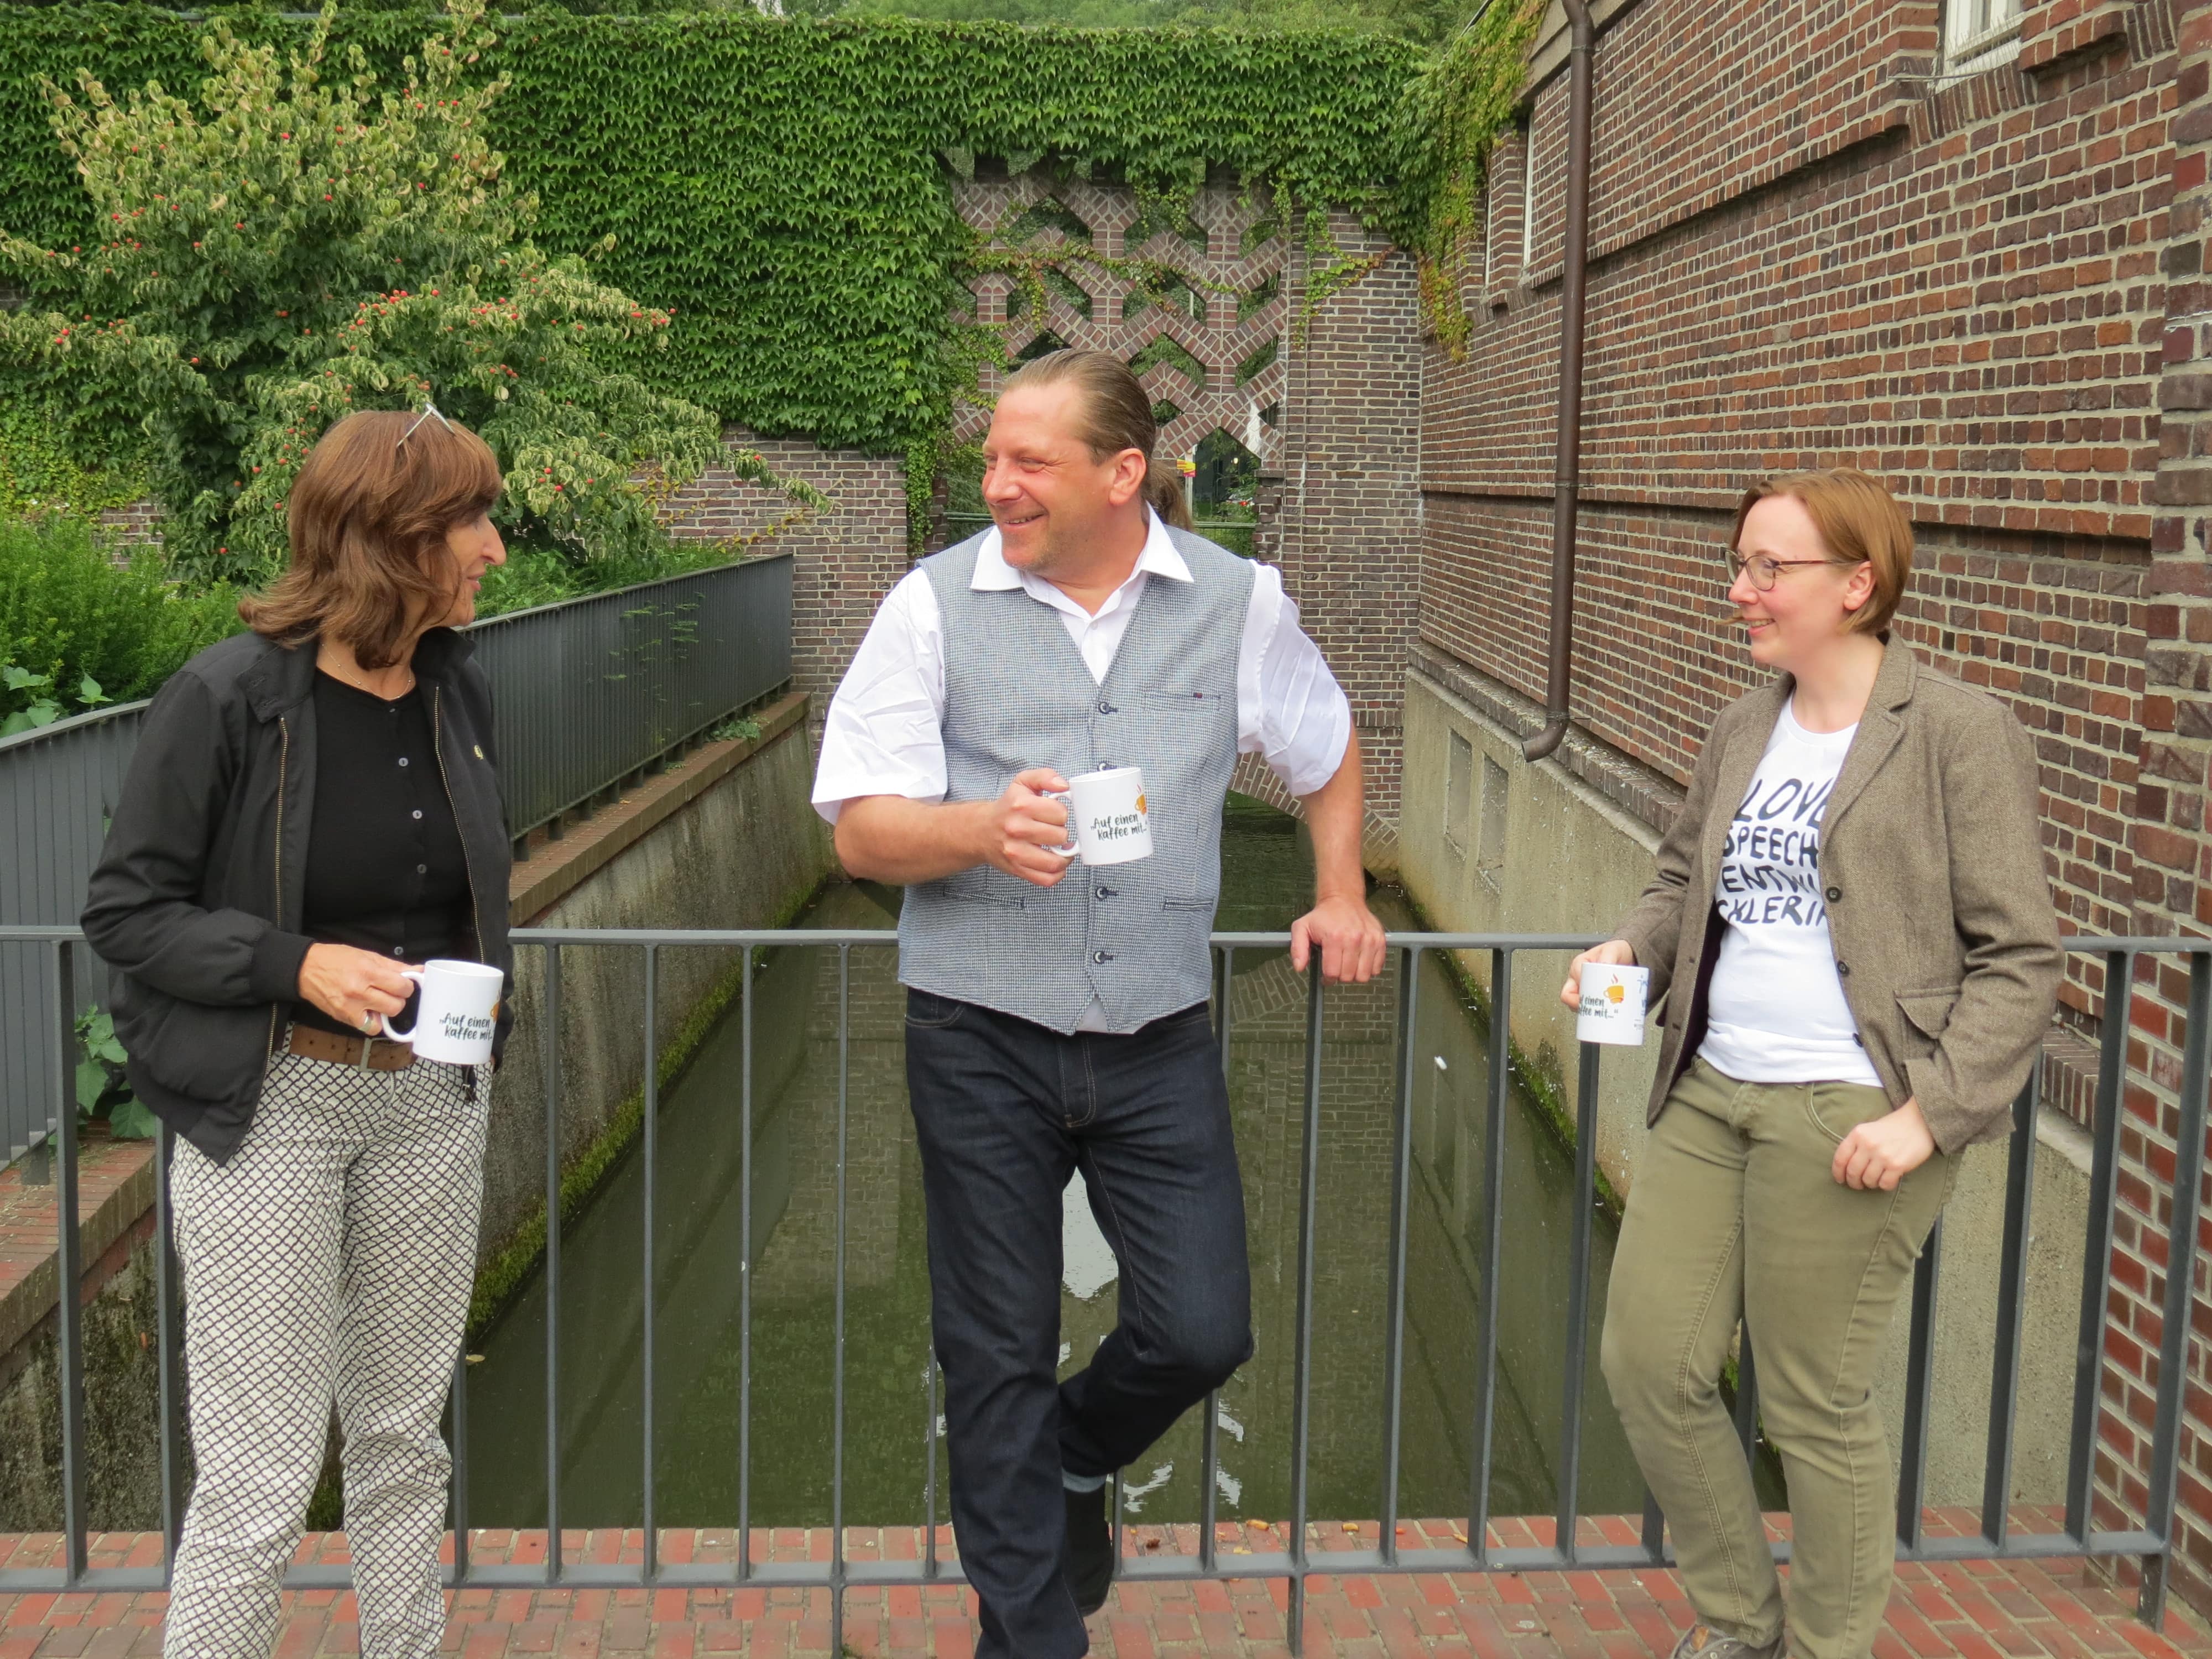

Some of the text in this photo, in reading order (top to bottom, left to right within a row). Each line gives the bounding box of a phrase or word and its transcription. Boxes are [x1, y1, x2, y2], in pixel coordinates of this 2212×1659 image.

[1115, 814, 1138, 826] einen
[1097, 827, 1129, 841] Kaffee
[1585, 995, 1604, 1006] einen
[467, 1016, 490, 1028] einen
[444, 1025, 478, 1041] Kaffee
